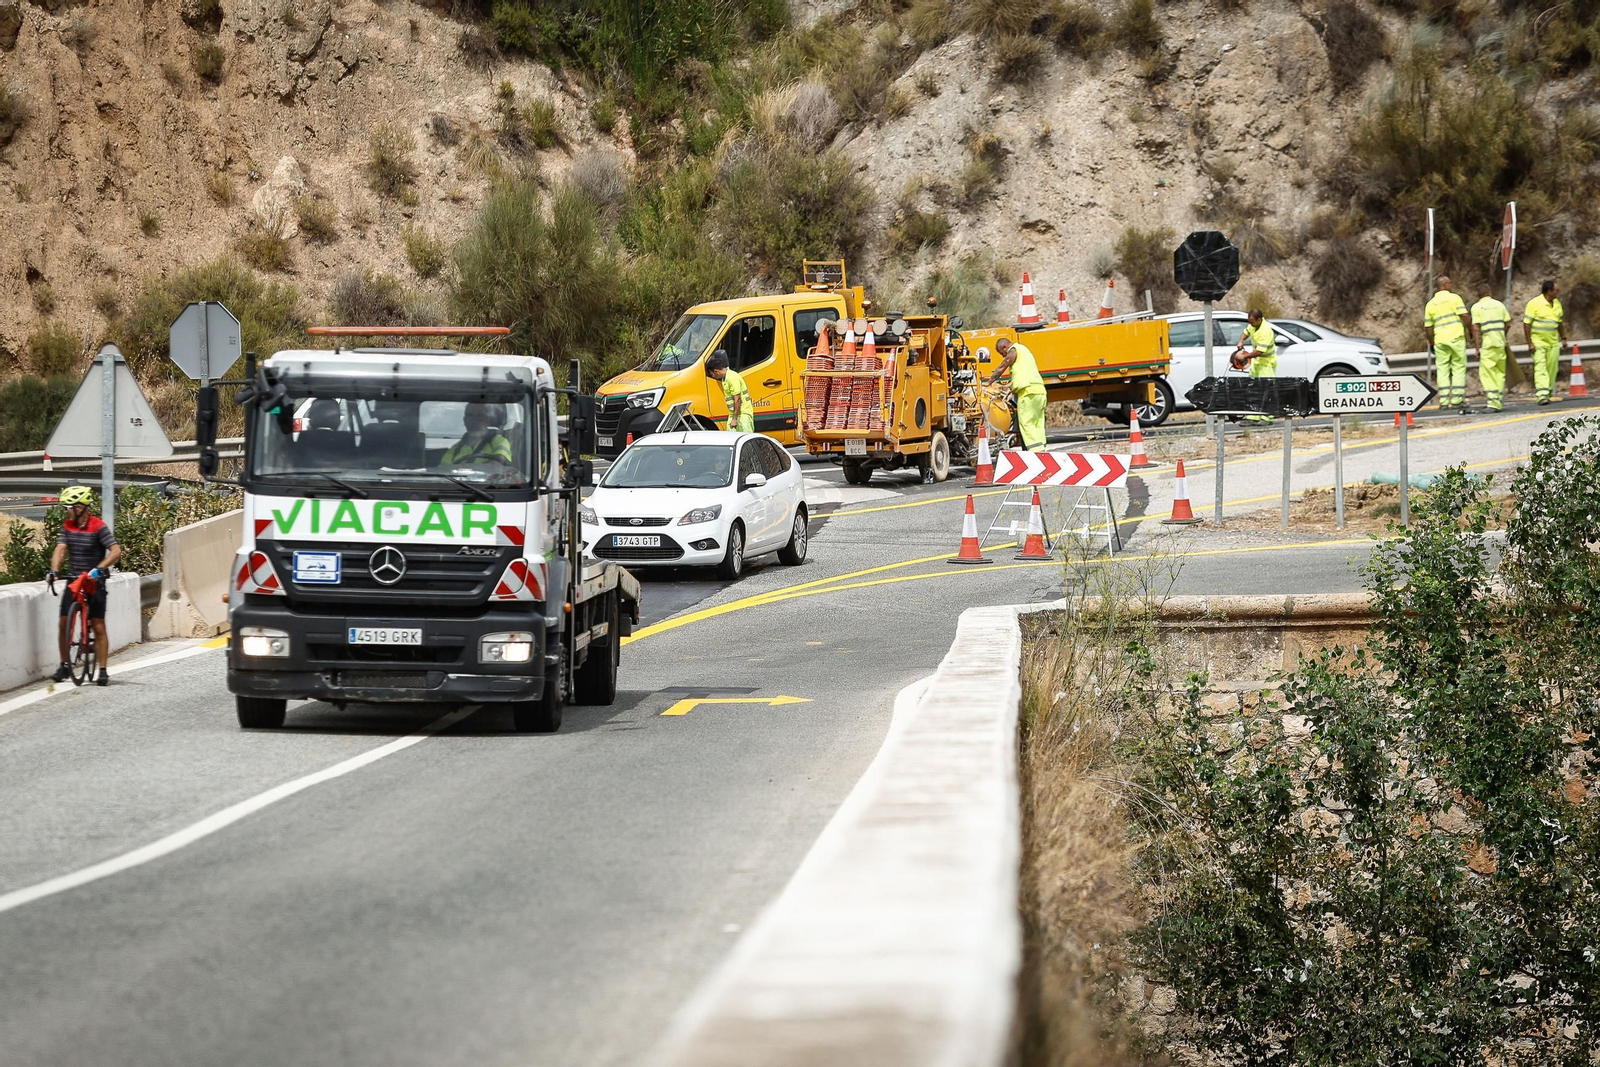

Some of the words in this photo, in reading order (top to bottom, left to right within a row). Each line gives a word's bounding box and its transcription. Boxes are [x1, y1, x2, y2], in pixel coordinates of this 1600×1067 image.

[1336, 383, 1366, 392] E-902
[1369, 382, 1400, 391] N-323
[1323, 398, 1384, 408] GRANADA
[1398, 396, 1414, 406] 53
[271, 499, 497, 538] VIACAR
[618, 537, 640, 546] 3743
[642, 537, 659, 546] GTP
[357, 630, 388, 643] 4519
[391, 631, 418, 643] GRK
